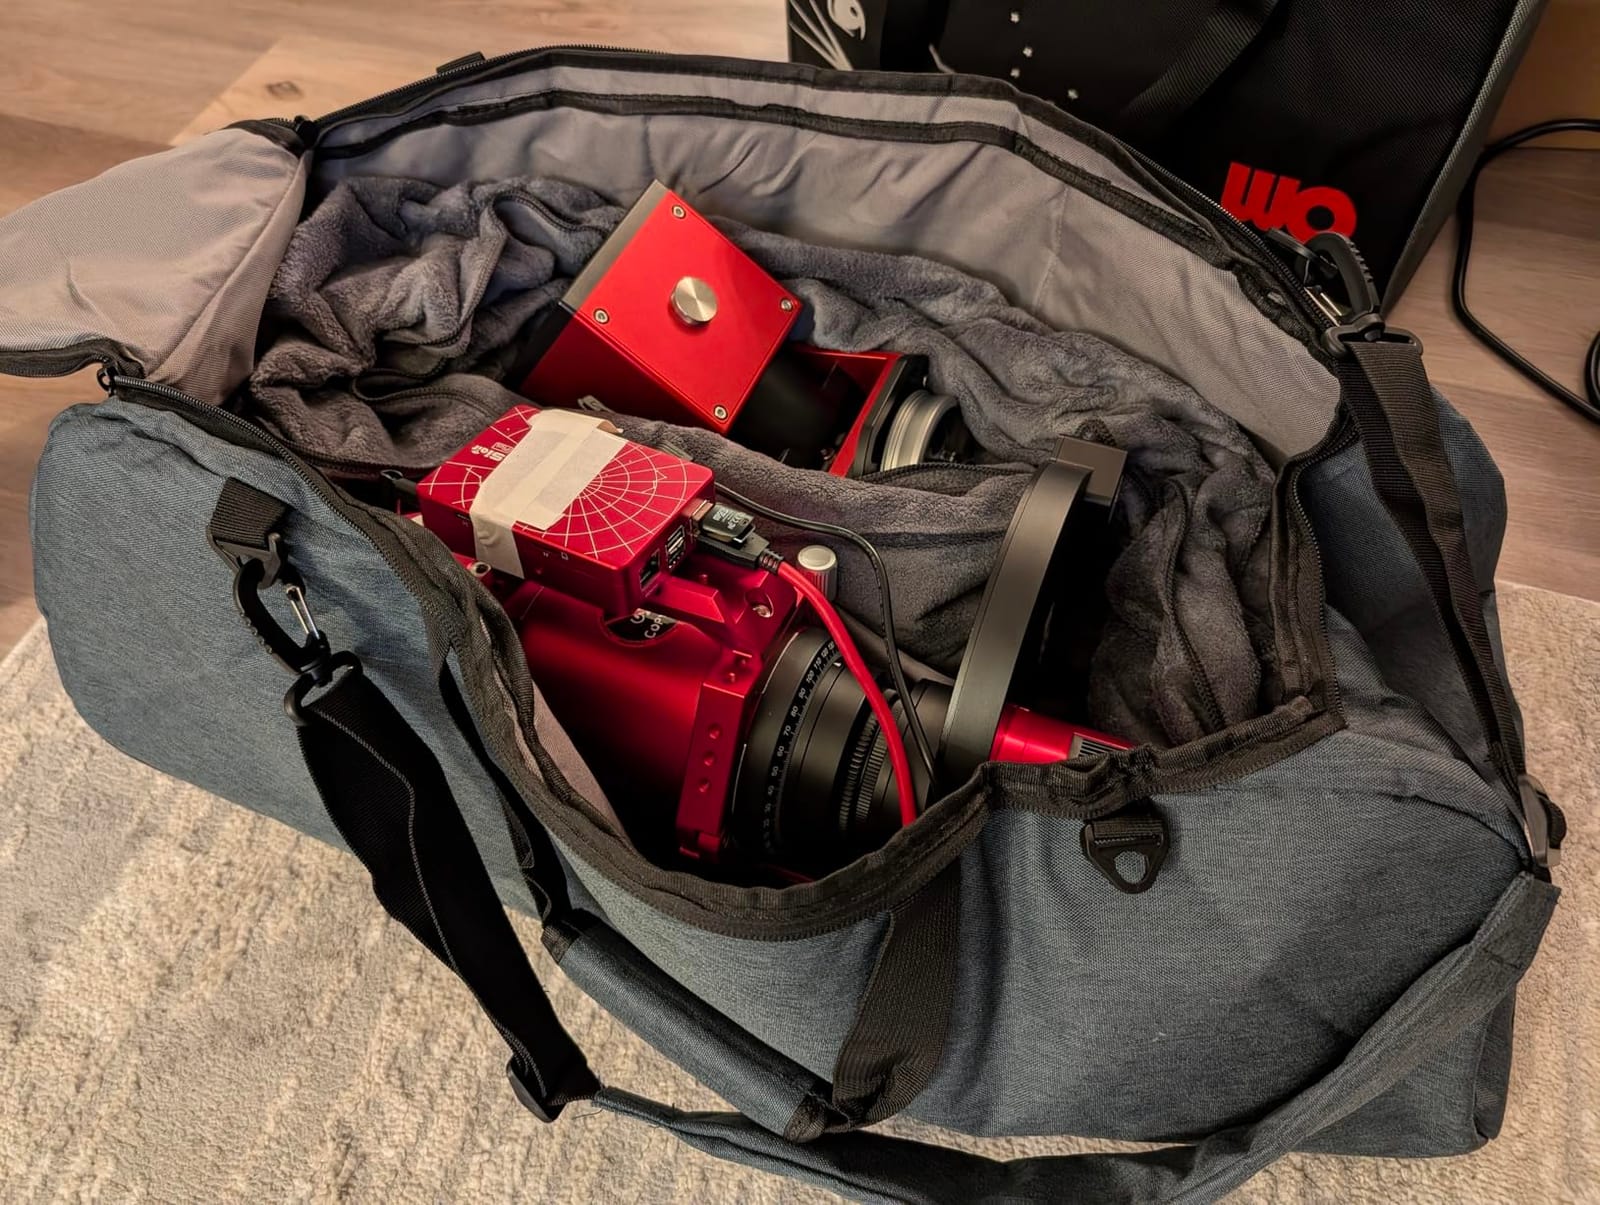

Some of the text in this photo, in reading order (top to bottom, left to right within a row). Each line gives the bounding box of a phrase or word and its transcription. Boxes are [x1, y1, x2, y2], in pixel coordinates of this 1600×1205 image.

[783, 725, 792, 737] 70
[790, 705, 799, 717] 80
[806, 670, 815, 683] 100
